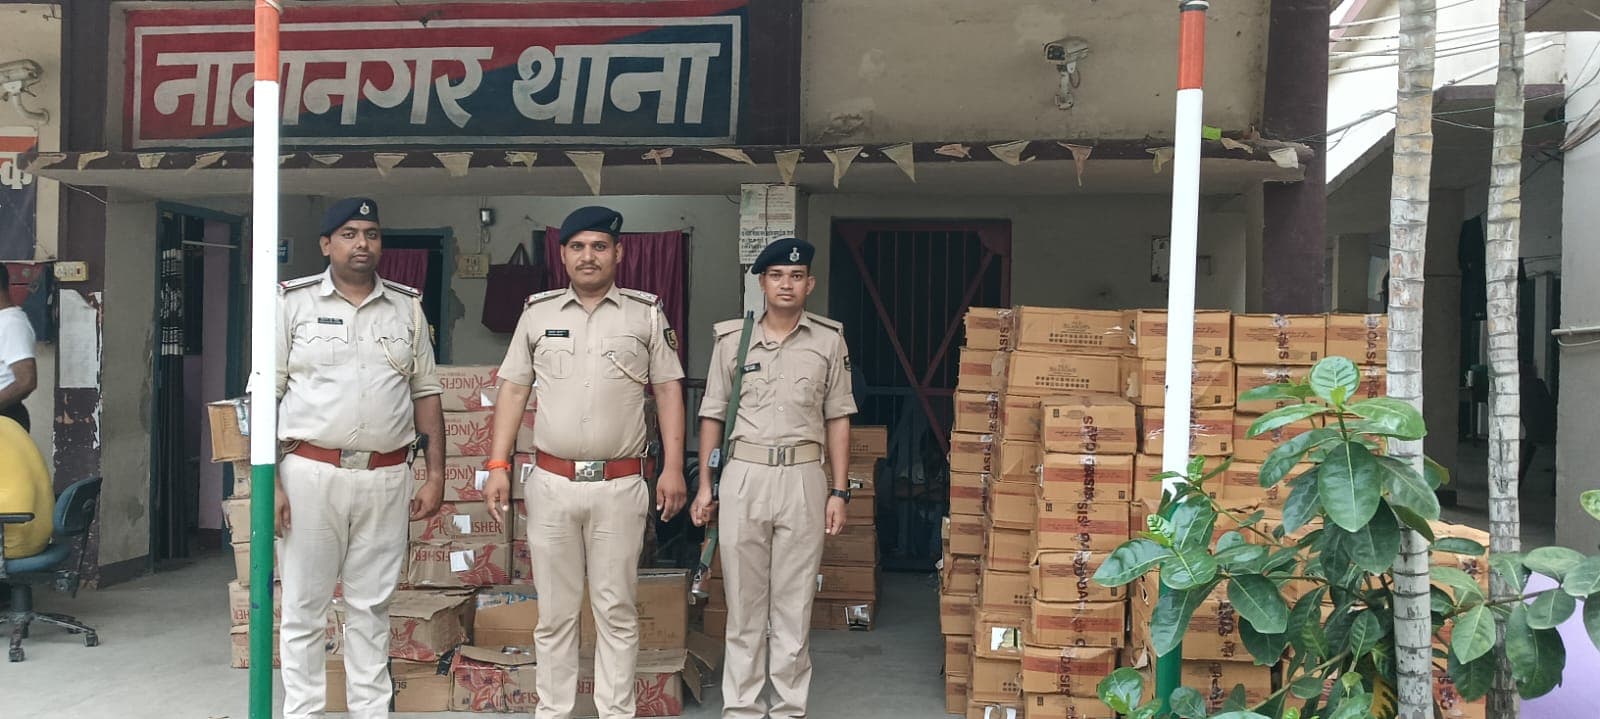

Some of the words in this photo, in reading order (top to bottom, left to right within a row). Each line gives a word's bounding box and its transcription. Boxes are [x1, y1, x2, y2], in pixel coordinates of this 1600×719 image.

[153, 46, 494, 128] नावानगर
[512, 42, 721, 124] थाना
[440, 374, 483, 391] KINGFIS
